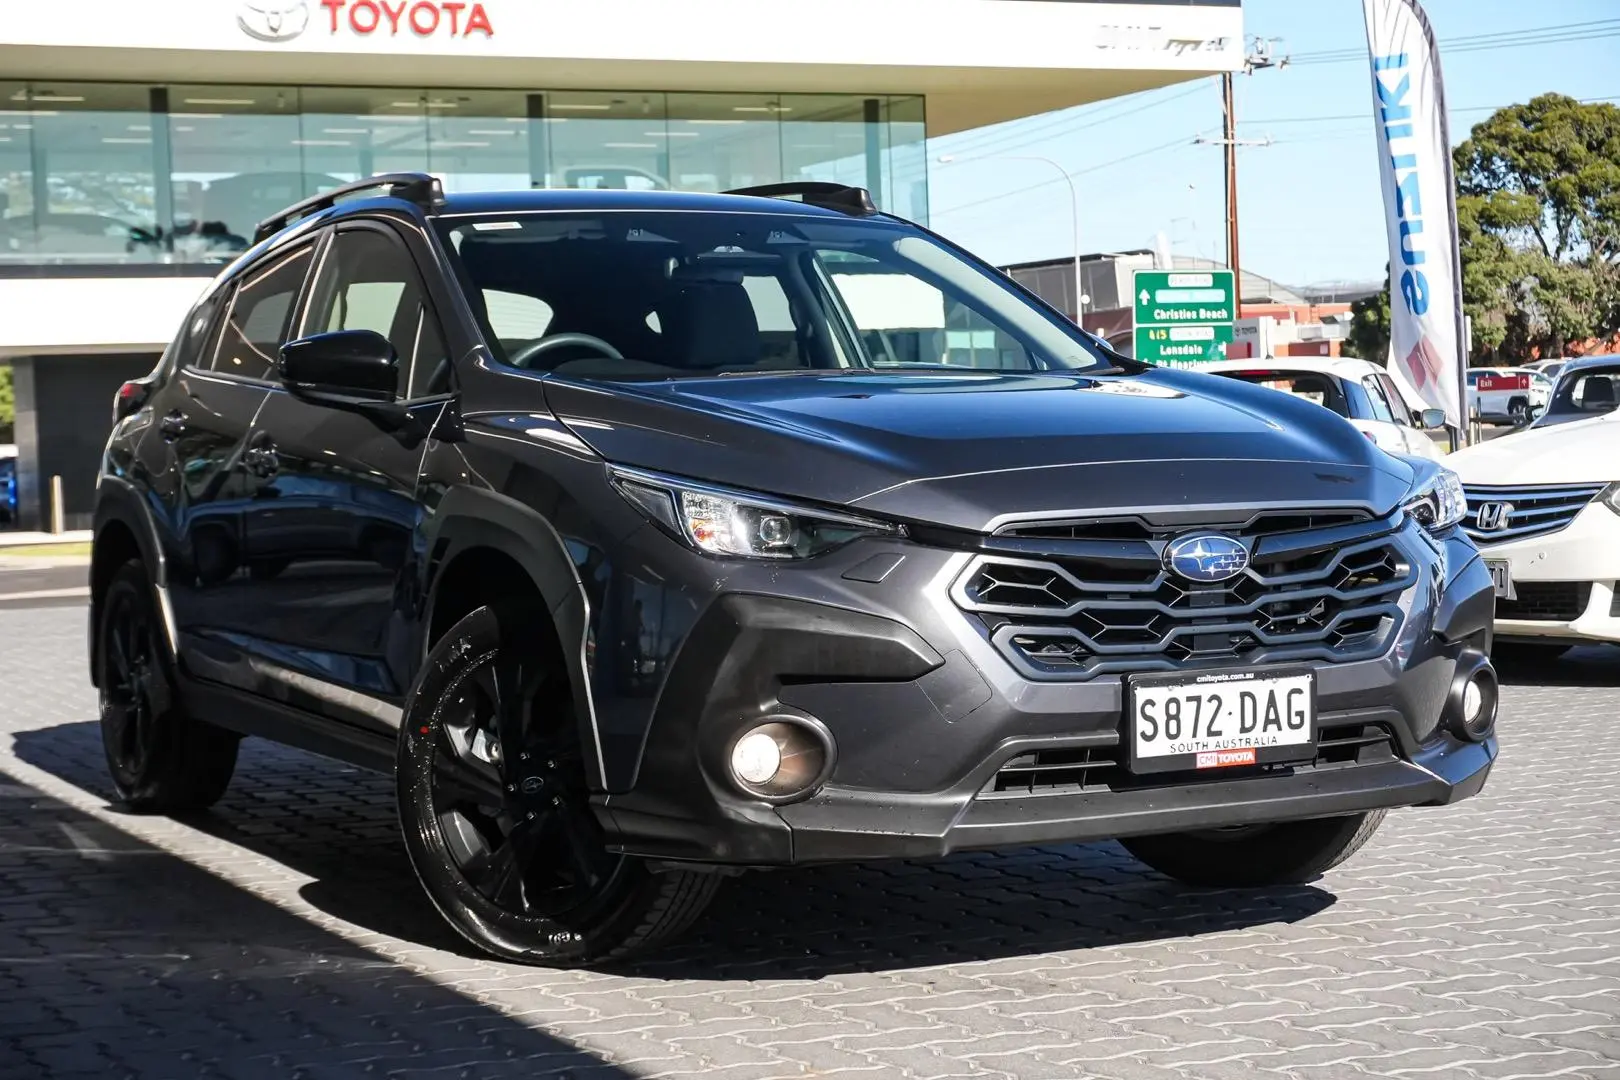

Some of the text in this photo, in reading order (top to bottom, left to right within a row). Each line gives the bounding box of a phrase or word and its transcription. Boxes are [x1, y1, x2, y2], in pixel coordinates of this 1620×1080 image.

[320, 0, 495, 38] TOYOTA
[1153, 307, 1228, 320] Christies Beach
[1160, 344, 1203, 356] Lonsdale
[1480, 379, 1493, 388] Exit
[1196, 672, 1255, 683] cmitoyota.com.au
[1170, 735, 1278, 754] SOUTH AUSTRALIA
[1217, 751, 1254, 764] TOYOTA
